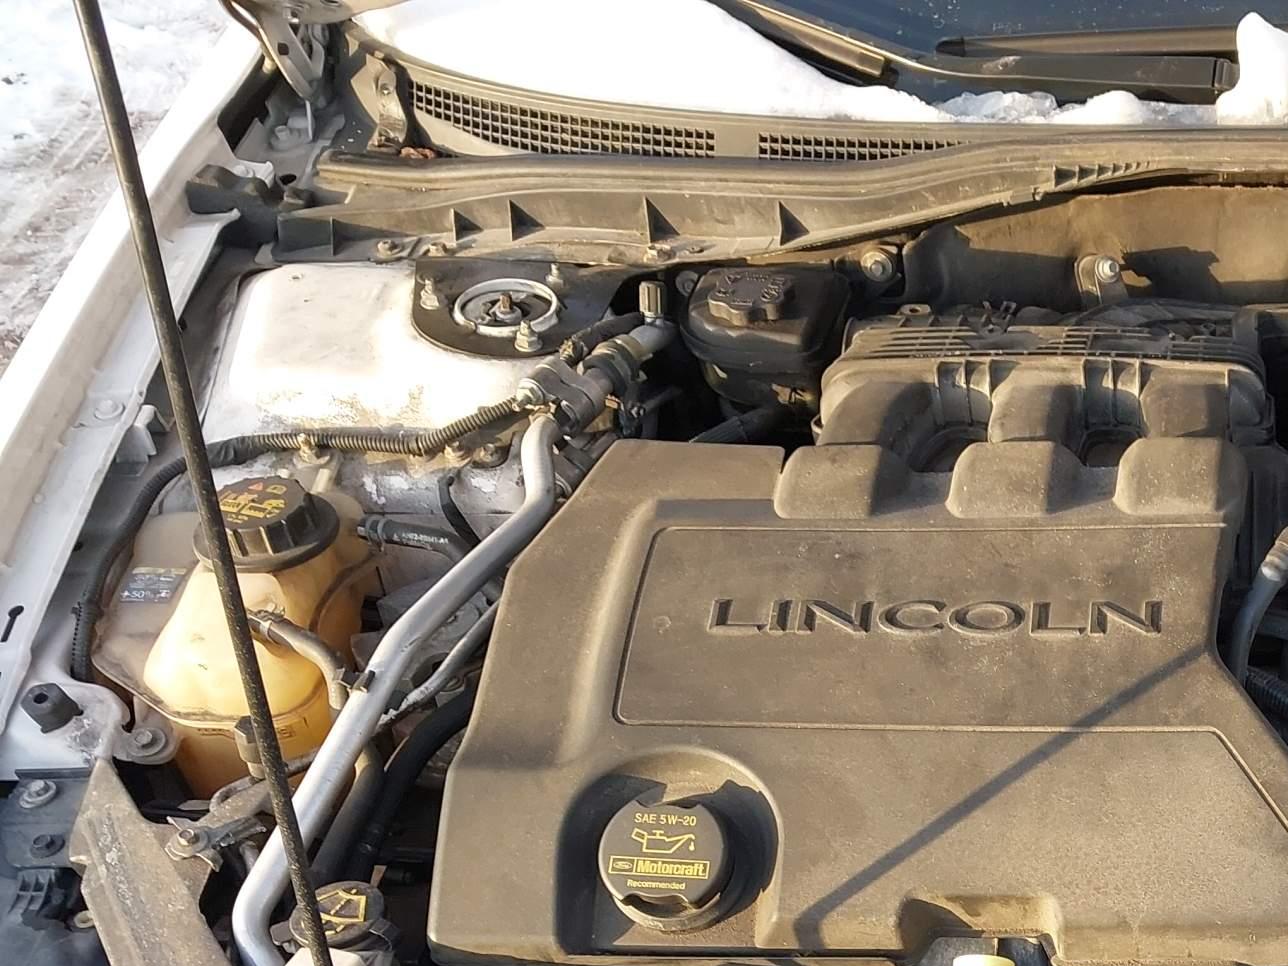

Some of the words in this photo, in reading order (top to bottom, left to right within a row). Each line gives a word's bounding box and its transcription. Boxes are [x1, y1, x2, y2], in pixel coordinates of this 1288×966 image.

[706, 598, 1164, 637] LINCOLN
[634, 812, 657, 824] SAE
[659, 813, 697, 826] 5W-20
[636, 860, 706, 876] Motorcraft
[626, 879, 686, 890] Recommended
